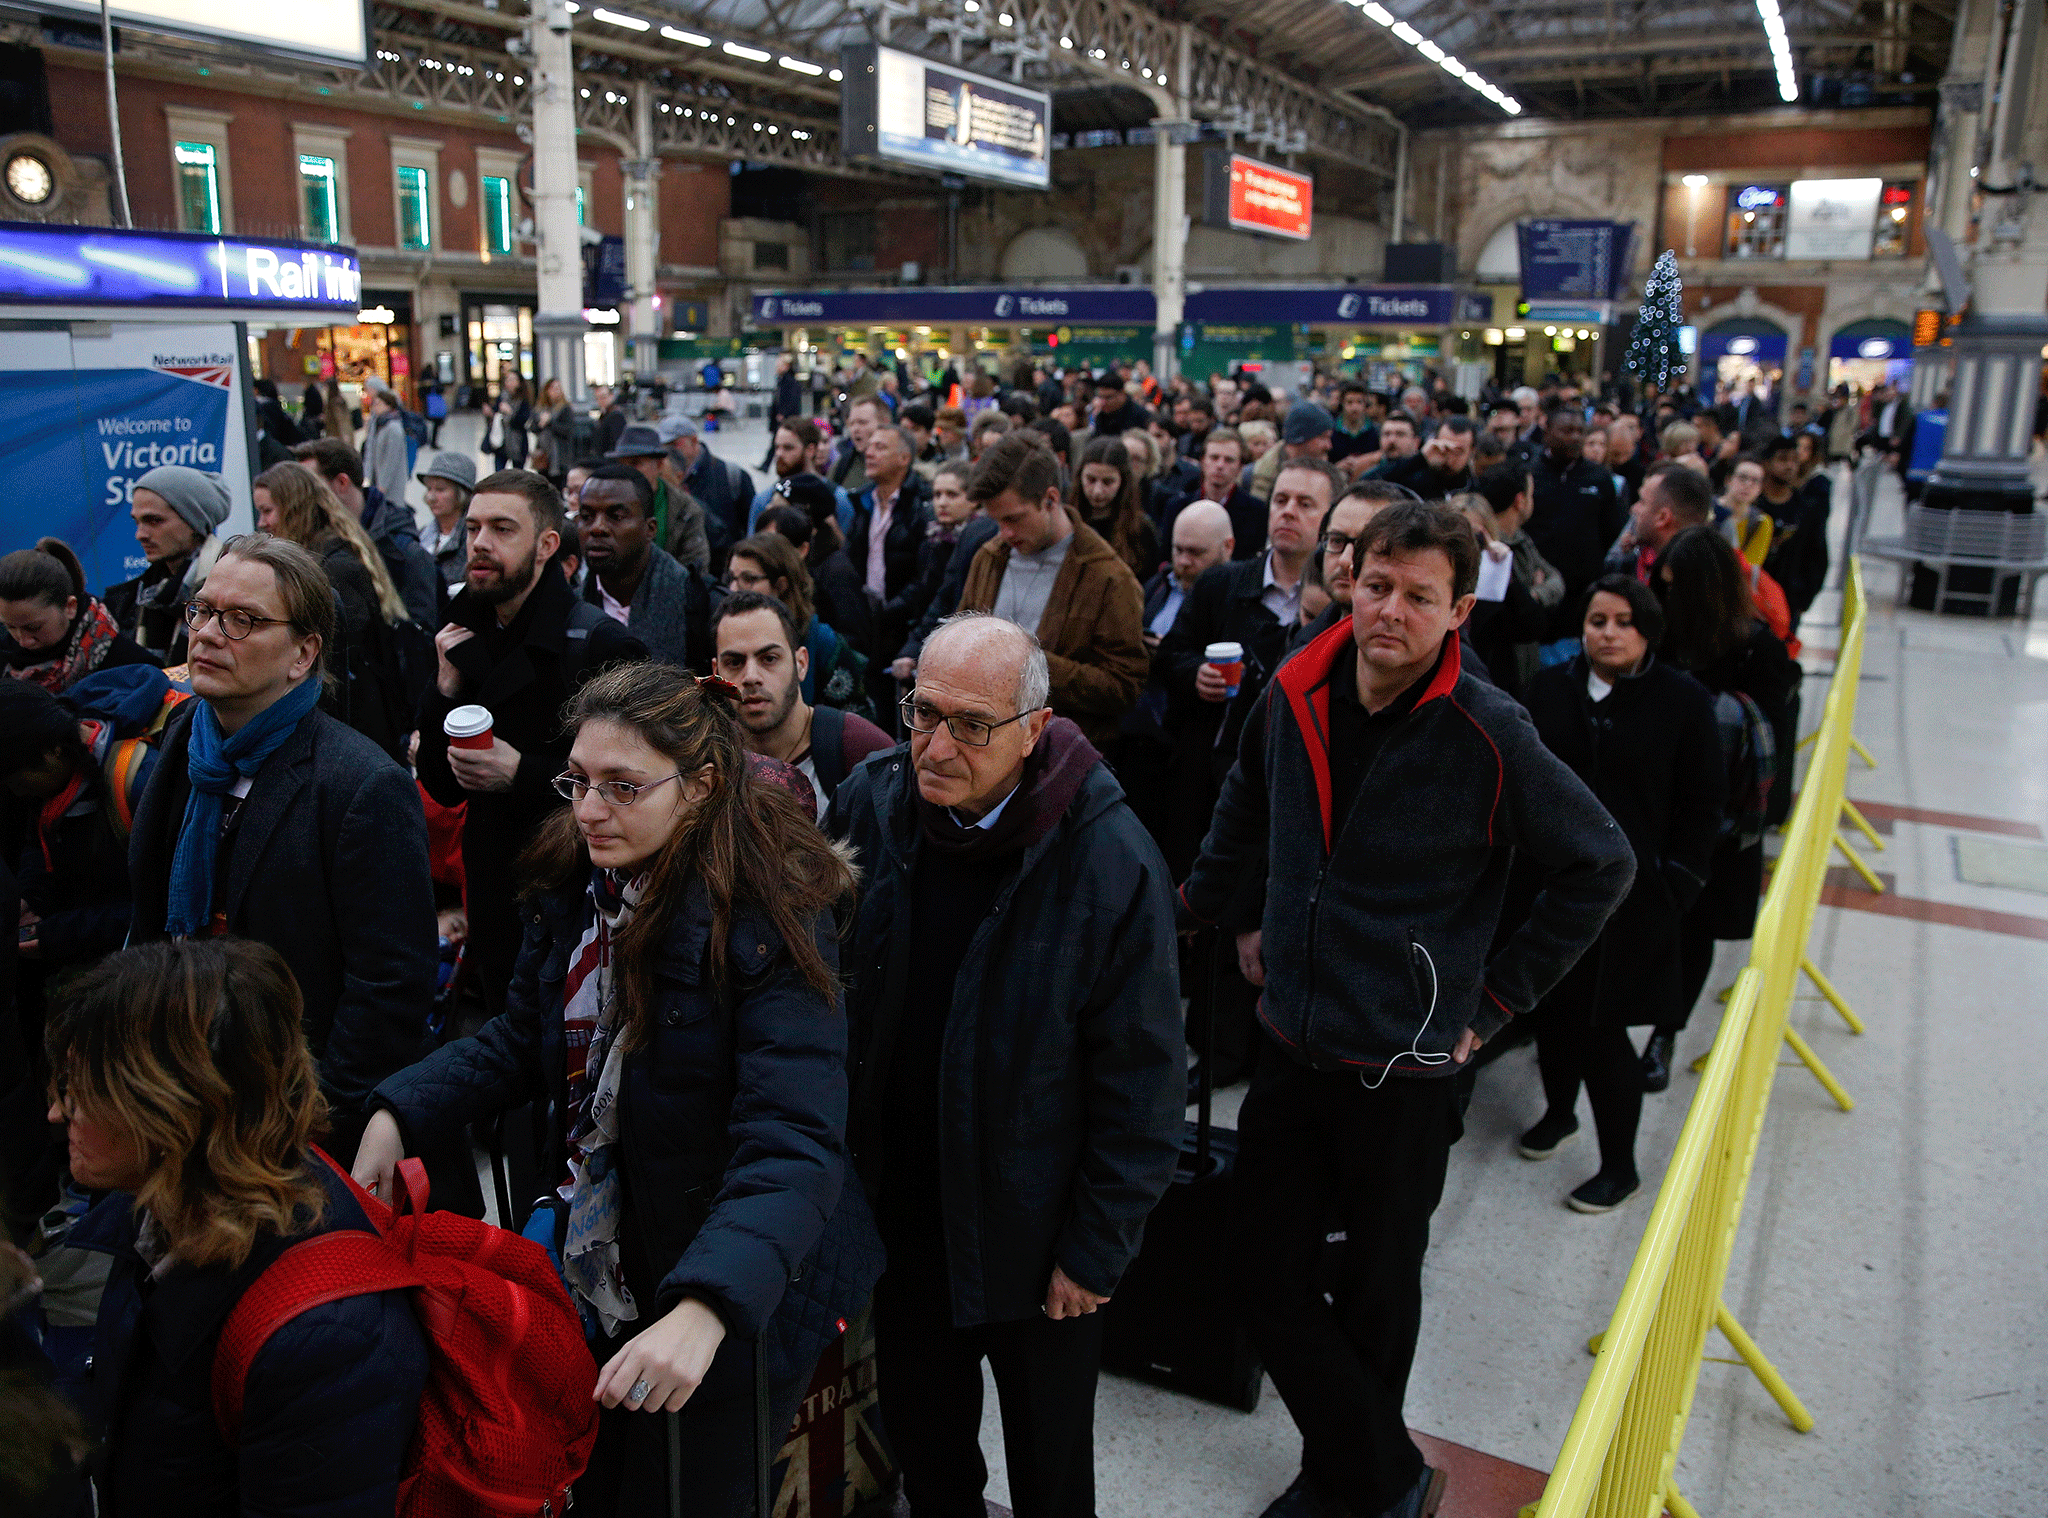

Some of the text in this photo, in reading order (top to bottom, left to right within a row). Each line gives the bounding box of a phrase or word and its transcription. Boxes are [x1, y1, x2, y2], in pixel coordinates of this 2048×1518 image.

[246, 248, 319, 299] Rail
[781, 300, 824, 317] Tickets
[1019, 296, 1069, 316] Tickets
[1368, 295, 1428, 317] Tickets
[97, 416, 192, 436] Welcome to
[101, 438, 217, 470] Victoria
[105, 475, 135, 505] St
